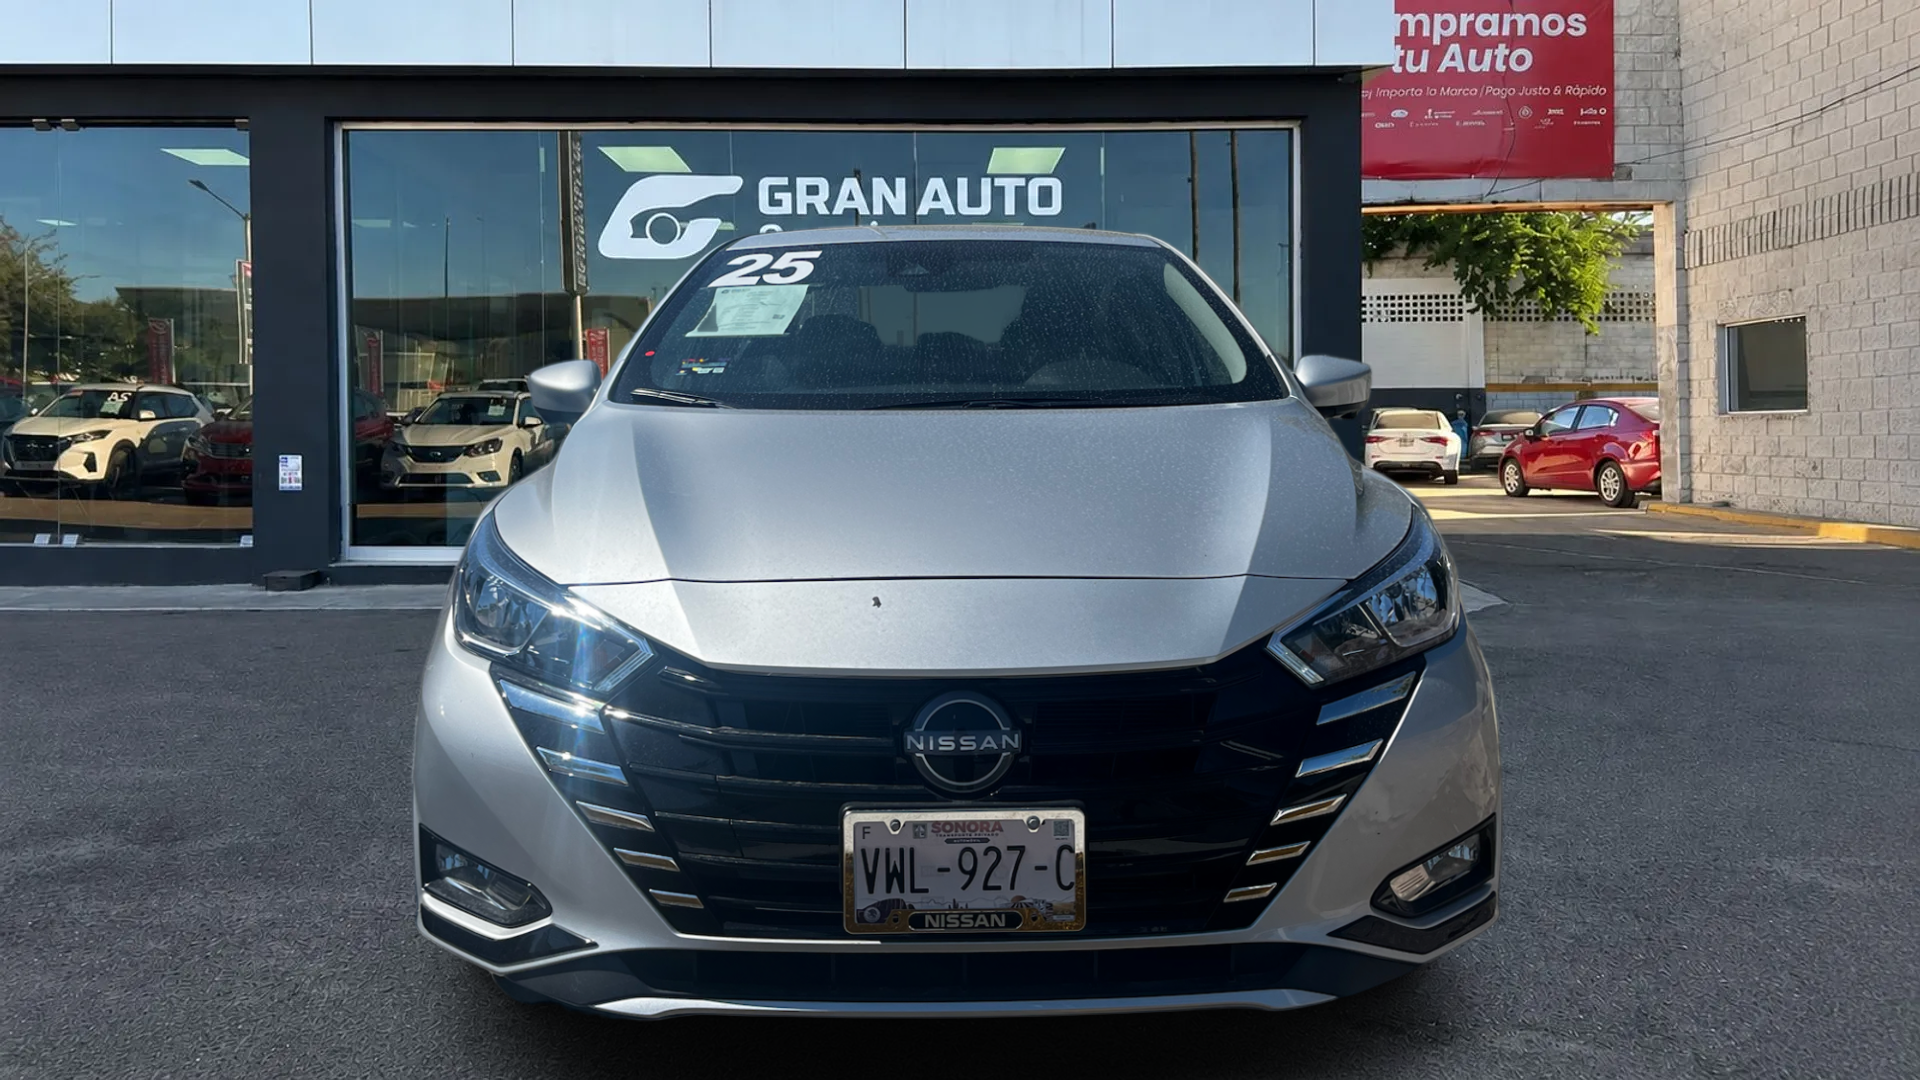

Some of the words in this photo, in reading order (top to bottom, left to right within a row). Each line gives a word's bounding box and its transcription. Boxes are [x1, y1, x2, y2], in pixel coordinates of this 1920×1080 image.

[1392, 44, 1430, 73] tu
[1436, 42, 1533, 73] Auto
[1376, 86, 1423, 100] Importa
[1426, 86, 1437, 97] la
[1439, 86, 1478, 97] Marca
[1518, 85, 1550, 97] Justo
[1553, 85, 1562, 97] &
[758, 176, 907, 216] GRAN
[917, 176, 1063, 216] AUTO
[707, 250, 823, 288] 25
[906, 733, 1020, 751] NISSAN
[861, 826, 871, 839] F
[931, 820, 1004, 834] SONORA
[924, 913, 1006, 929] NISSAN
